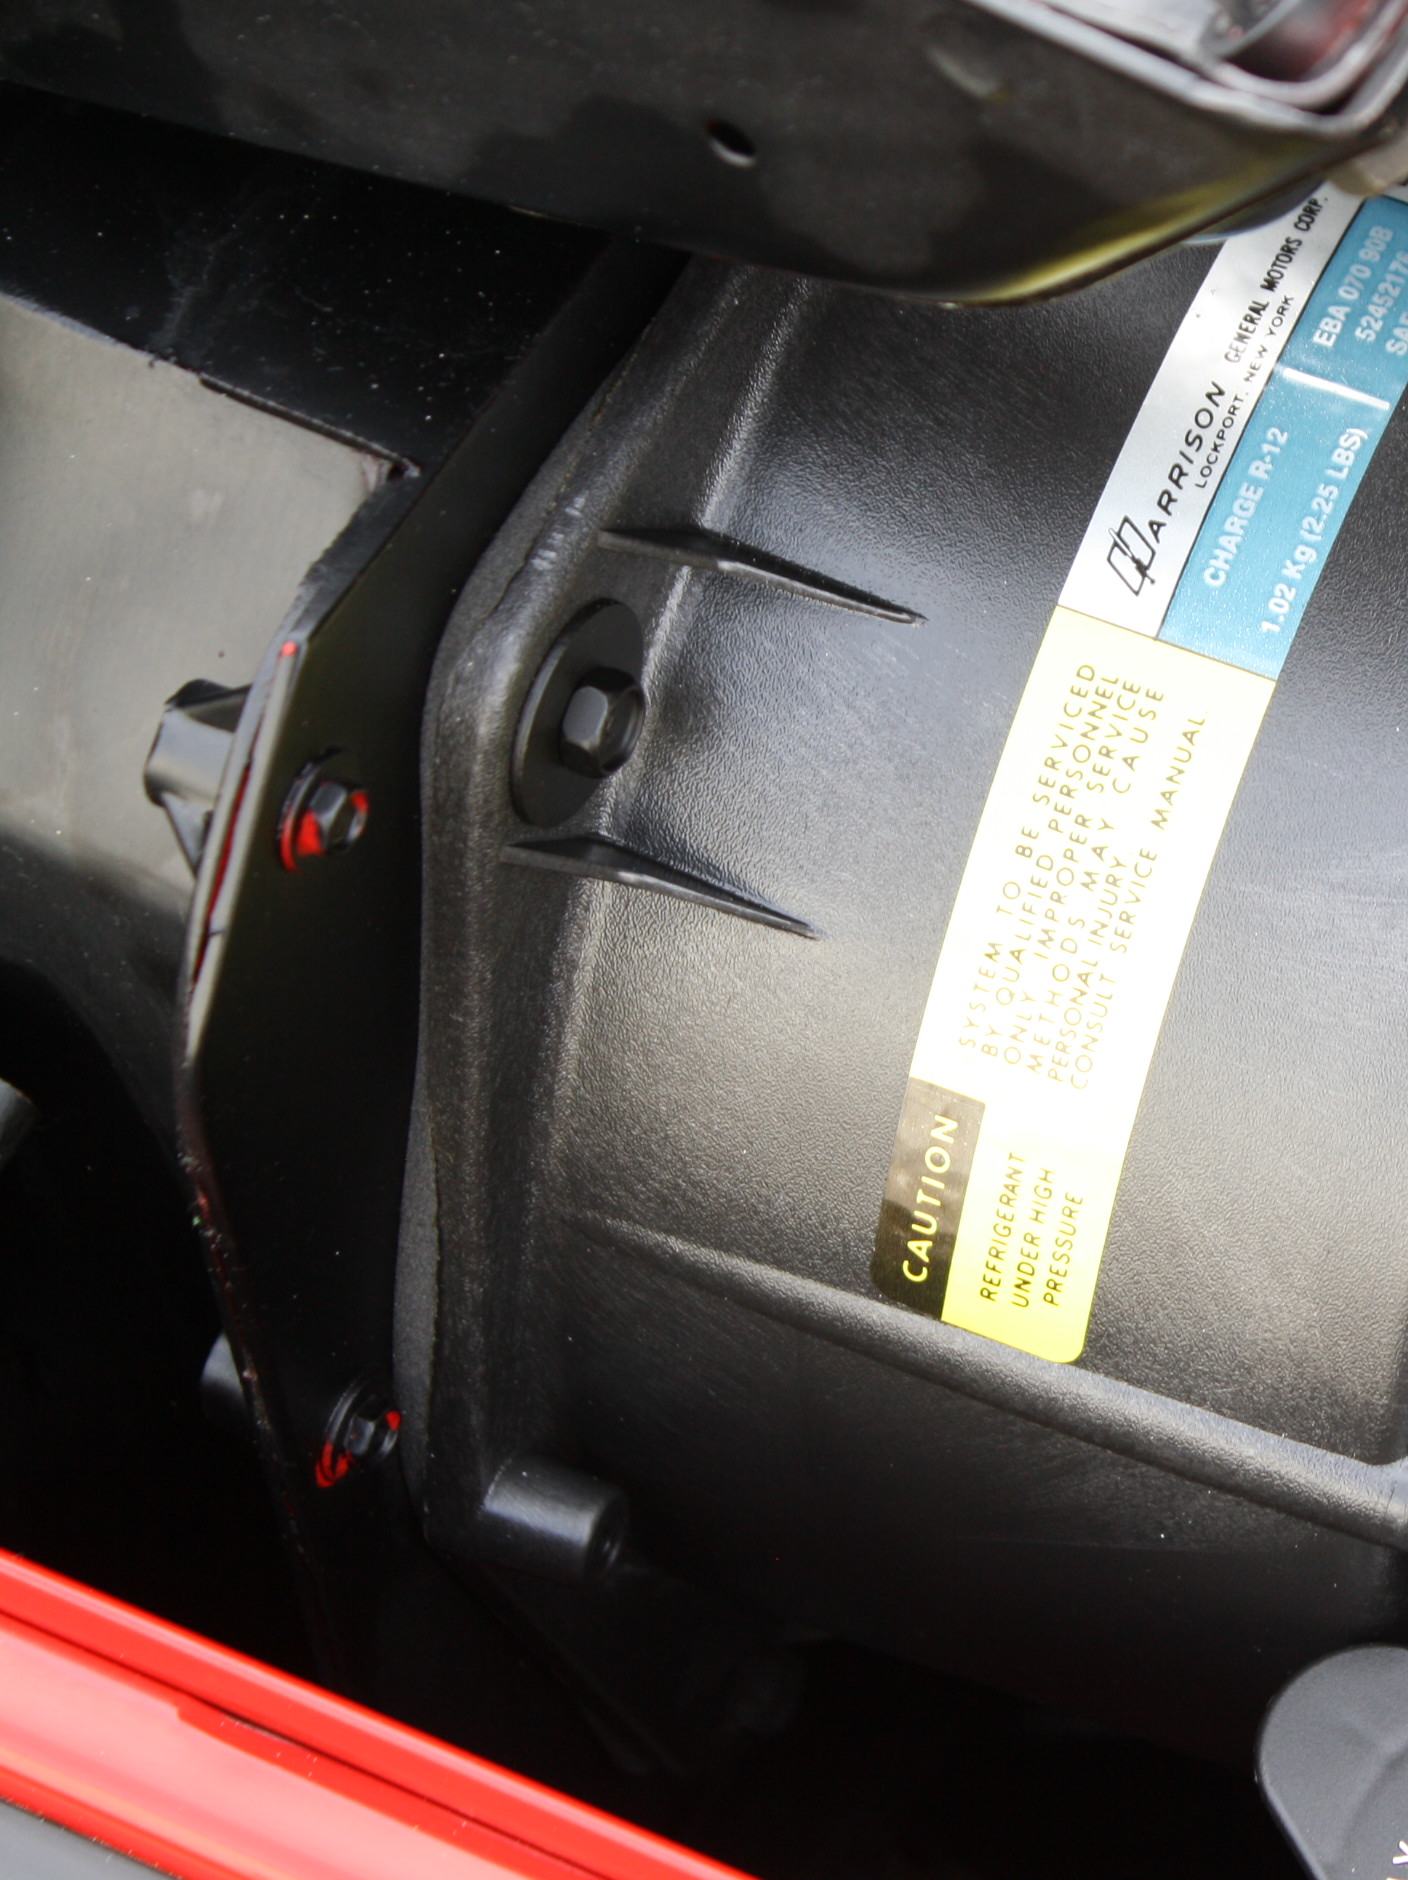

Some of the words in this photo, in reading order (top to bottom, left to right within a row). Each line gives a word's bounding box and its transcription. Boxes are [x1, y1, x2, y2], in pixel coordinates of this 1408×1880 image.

[1224, 300, 1270, 360] GENERAL
[1260, 236, 1303, 292] MOTORS
[1293, 196, 1330, 233] CORP.
[1243, 344, 1268, 382] NEW
[1268, 295, 1293, 336] YORK
[1311, 306, 1350, 349] EBA
[1337, 264, 1371, 301] 070
[1202, 482, 1264, 588] CHARGE
[1248, 427, 1289, 480] R-12
[1299, 483, 1339, 542] (2.25
[1326, 427, 1369, 480] LBS)
[1260, 583, 1299, 635] 1.02
[1281, 544, 1318, 581] Kg
[958, 942, 1003, 1048] SYSTEM
[995, 880, 1022, 915] TO
[1014, 827, 1040, 859] BE
[1032, 664, 1096, 806] SERVICED
[980, 1025, 1002, 1057] BY
[995, 854, 1054, 1006] QUALIFIED
[1047, 676, 1120, 834] PERSONNEL
[1003, 991, 1037, 1065] ONLY
[1032, 813, 1093, 960] IMPROPER
[1085, 680, 1142, 793] SERVICE
[1026, 916, 1086, 1074] METHODS
[1079, 817, 1115, 893] MAY
[1111, 687, 1165, 794] CAUSE
[1047, 959, 1099, 1083] PERSONAL
[1069, 972, 1117, 1090] CONSULT
[1109, 847, 1158, 953] SERVICE
[902, 1114, 959, 1282] CAUTION
[977, 1152, 1028, 1303] REFRIGERANT
[1010, 1232, 1040, 1309] UNDER
[1027, 1166, 1057, 1225] HIGH
[1042, 1195, 1083, 1308] PRESSURE
